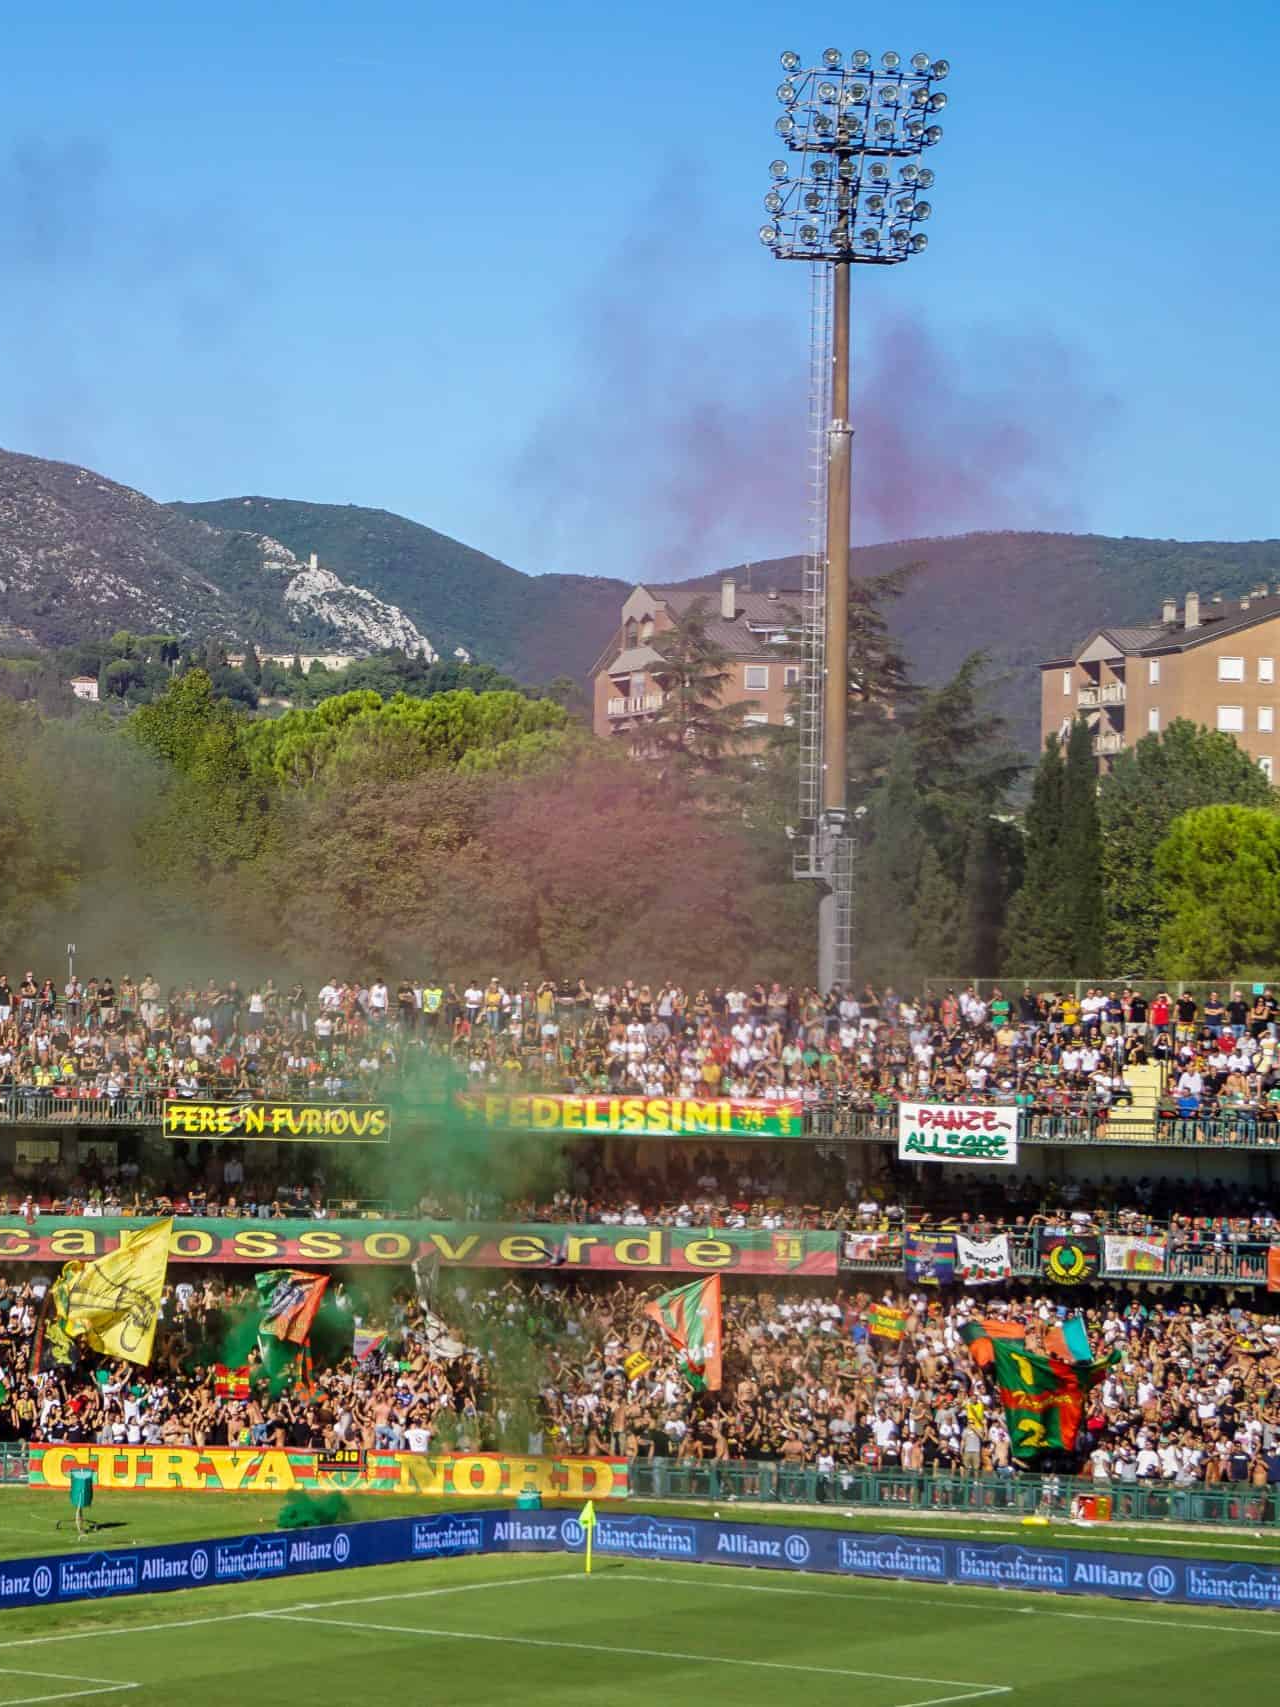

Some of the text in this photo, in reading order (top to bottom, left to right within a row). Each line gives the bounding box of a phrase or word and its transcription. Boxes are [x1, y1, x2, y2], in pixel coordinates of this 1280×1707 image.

[169, 1106, 233, 1134] FERE
[272, 1107, 386, 1136] FURIOUS
[484, 1098, 731, 1132] FEDELISSIMI
[41, 1447, 615, 1499] CURVA NORD
[415, 1521, 480, 1549] biancafarina
[494, 1521, 557, 1541] Allianz
[596, 1524, 692, 1552] biancafarina
[717, 1532, 781, 1557] Allianz
[215, 1543, 285, 1576] biancafarina
[289, 1541, 332, 1562] Allianz
[841, 1538, 942, 1574] biancafarina
[61, 1555, 135, 1592] biancafarina
[142, 1558, 189, 1580] Allianz
[960, 1549, 1065, 1585] biancafarina
[1073, 1562, 1143, 1588] Allianz
